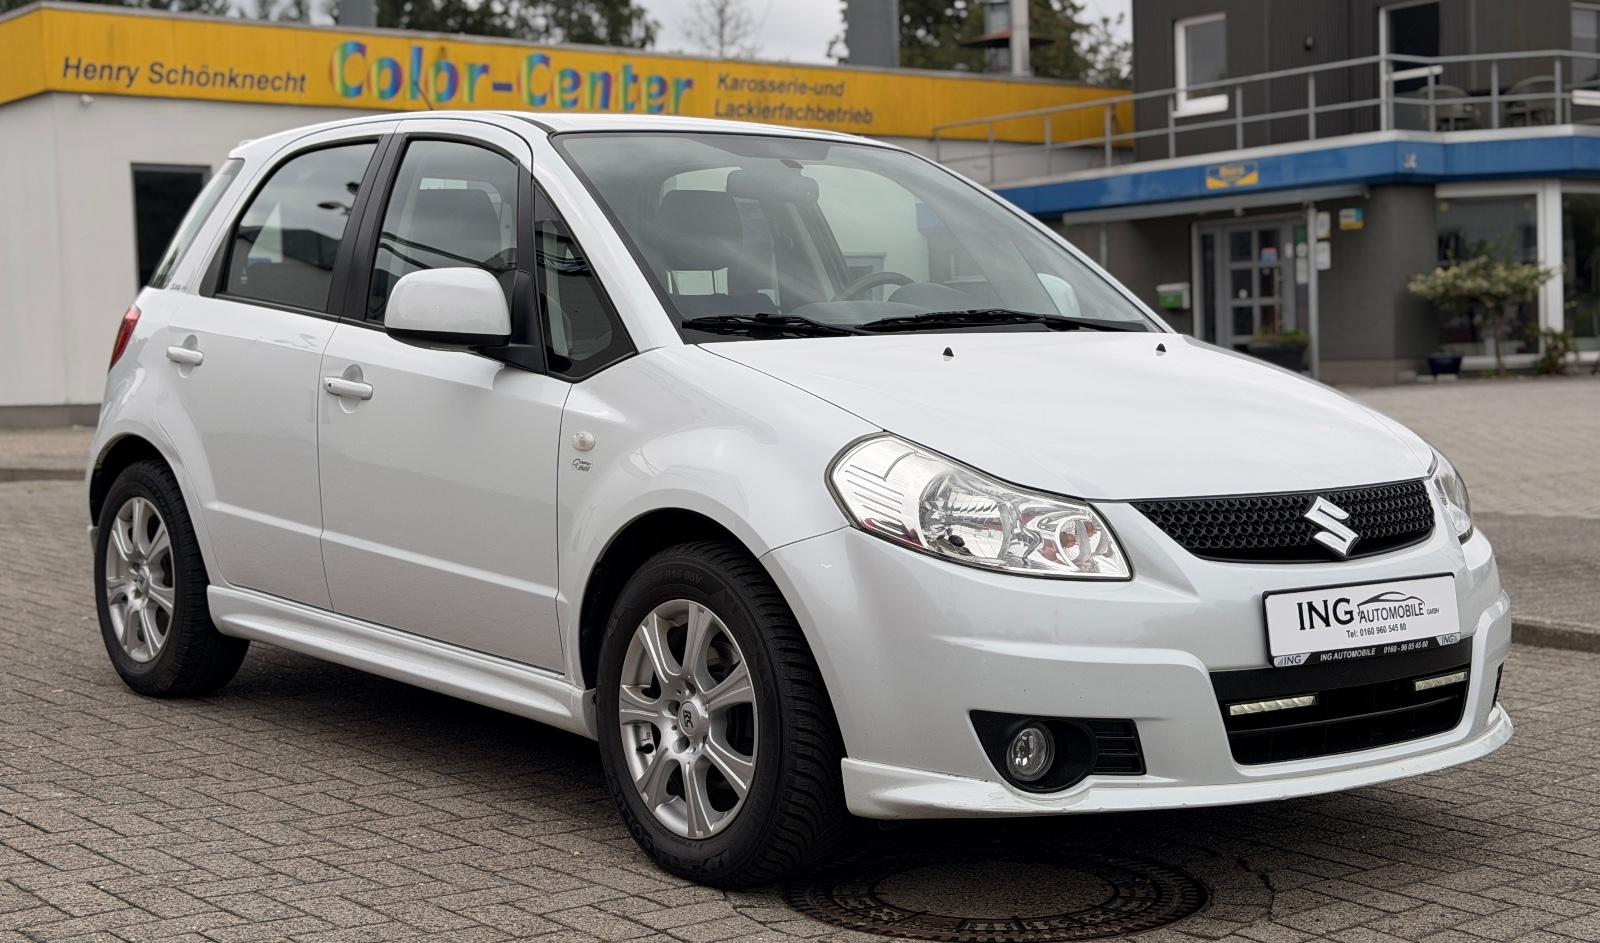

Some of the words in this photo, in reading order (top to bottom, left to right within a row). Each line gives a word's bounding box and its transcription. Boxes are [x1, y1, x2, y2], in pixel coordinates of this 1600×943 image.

[63, 56, 141, 88] Henry
[148, 61, 307, 93] Schönknecht
[329, 40, 694, 115] Color-Center
[714, 99, 874, 125] Lackierfachbetrieb
[1297, 598, 1355, 630] ING
[1359, 602, 1425, 624] AUTOMOBILE
[1346, 629, 1359, 639] Tel:
[1360, 626, 1375, 637] 0160
[1283, 655, 1302, 666] ING
[1320, 652, 1333, 662] ING
[1333, 648, 1376, 661] AUTOMOBILE
[1441, 635, 1454, 646] ING
